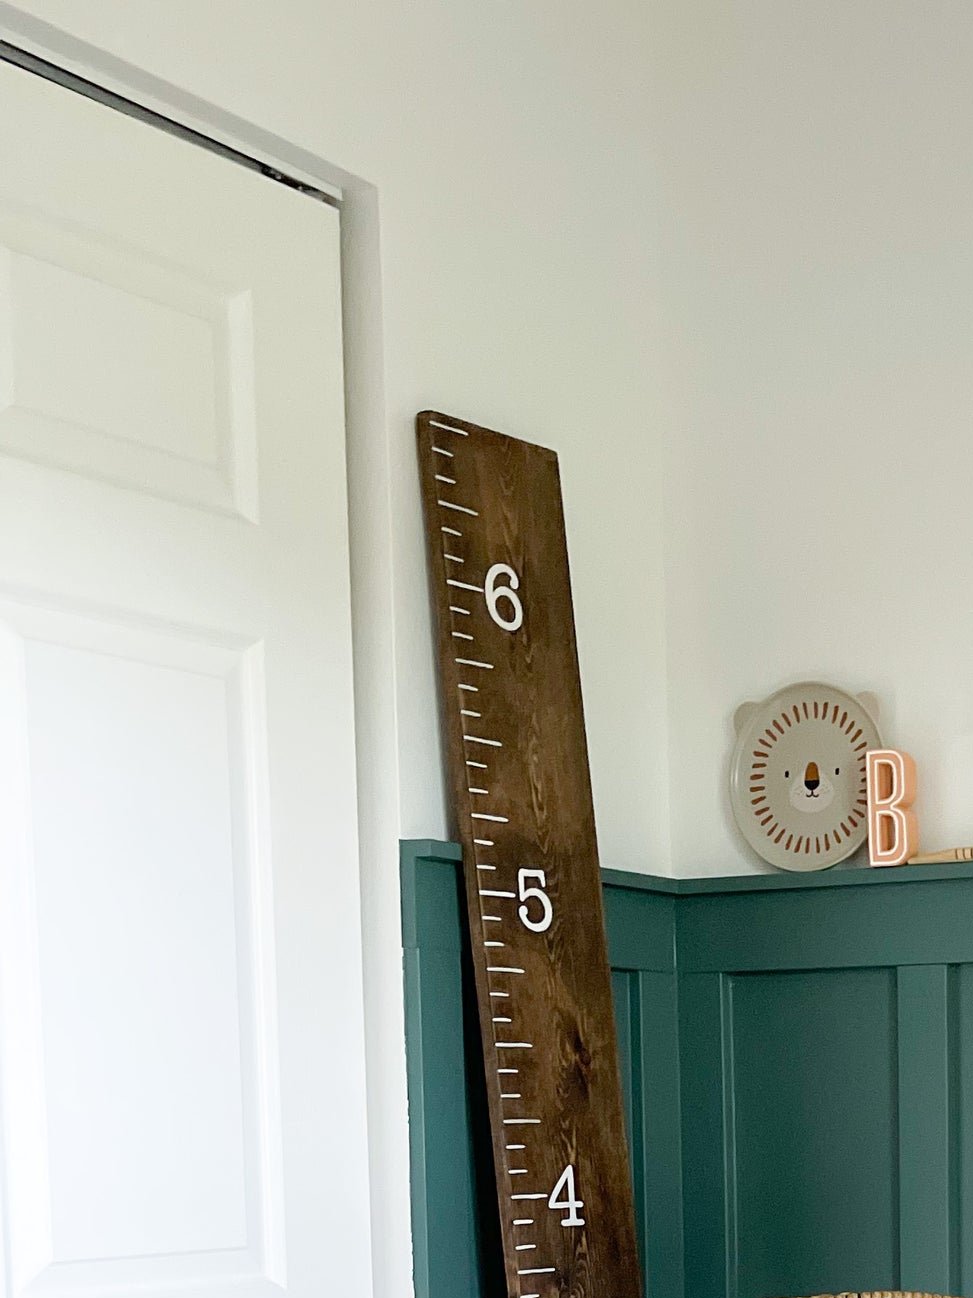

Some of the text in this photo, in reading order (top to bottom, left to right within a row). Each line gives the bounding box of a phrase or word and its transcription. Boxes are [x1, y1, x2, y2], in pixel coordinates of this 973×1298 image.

[484, 563, 523, 631] 6
[866, 749, 918, 867] B
[517, 868, 553, 933] 5
[548, 1164, 586, 1227] 4
